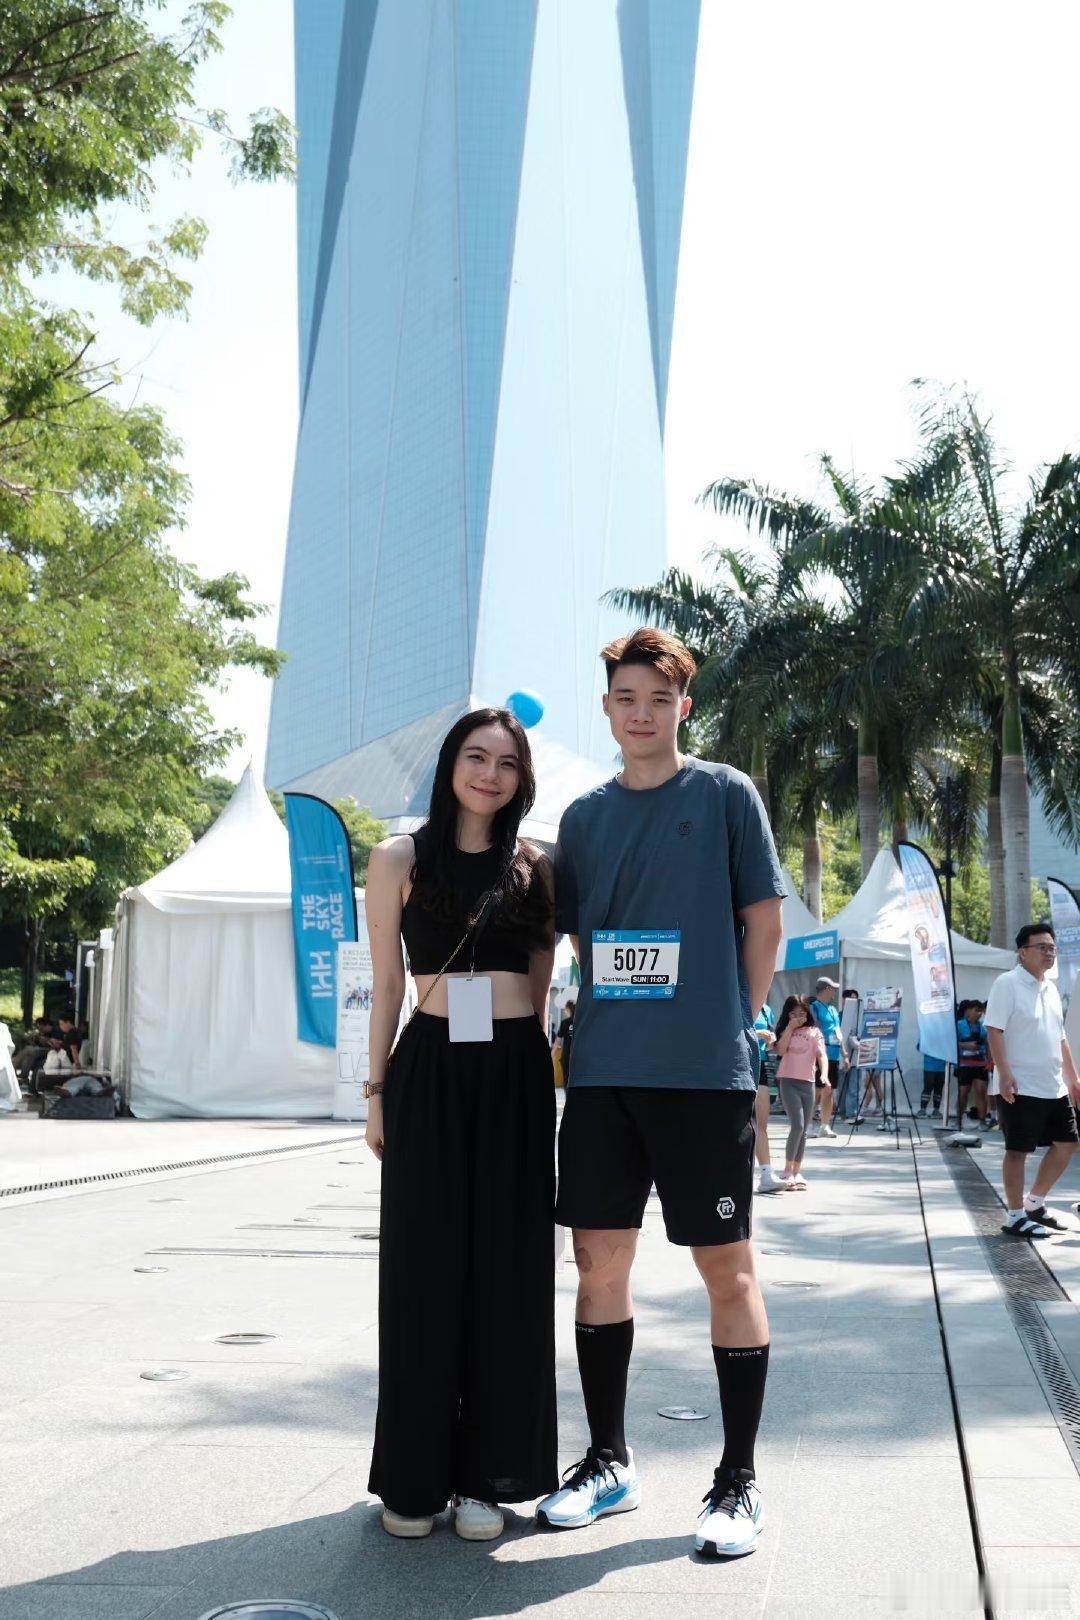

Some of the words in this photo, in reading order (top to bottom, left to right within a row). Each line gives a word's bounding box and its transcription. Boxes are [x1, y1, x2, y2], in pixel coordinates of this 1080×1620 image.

[302, 894, 316, 931] THE
[316, 894, 331, 931] SKY
[330, 892, 346, 939] RACE
[309, 950, 334, 998] IHH
[614, 948, 660, 971] 5077
